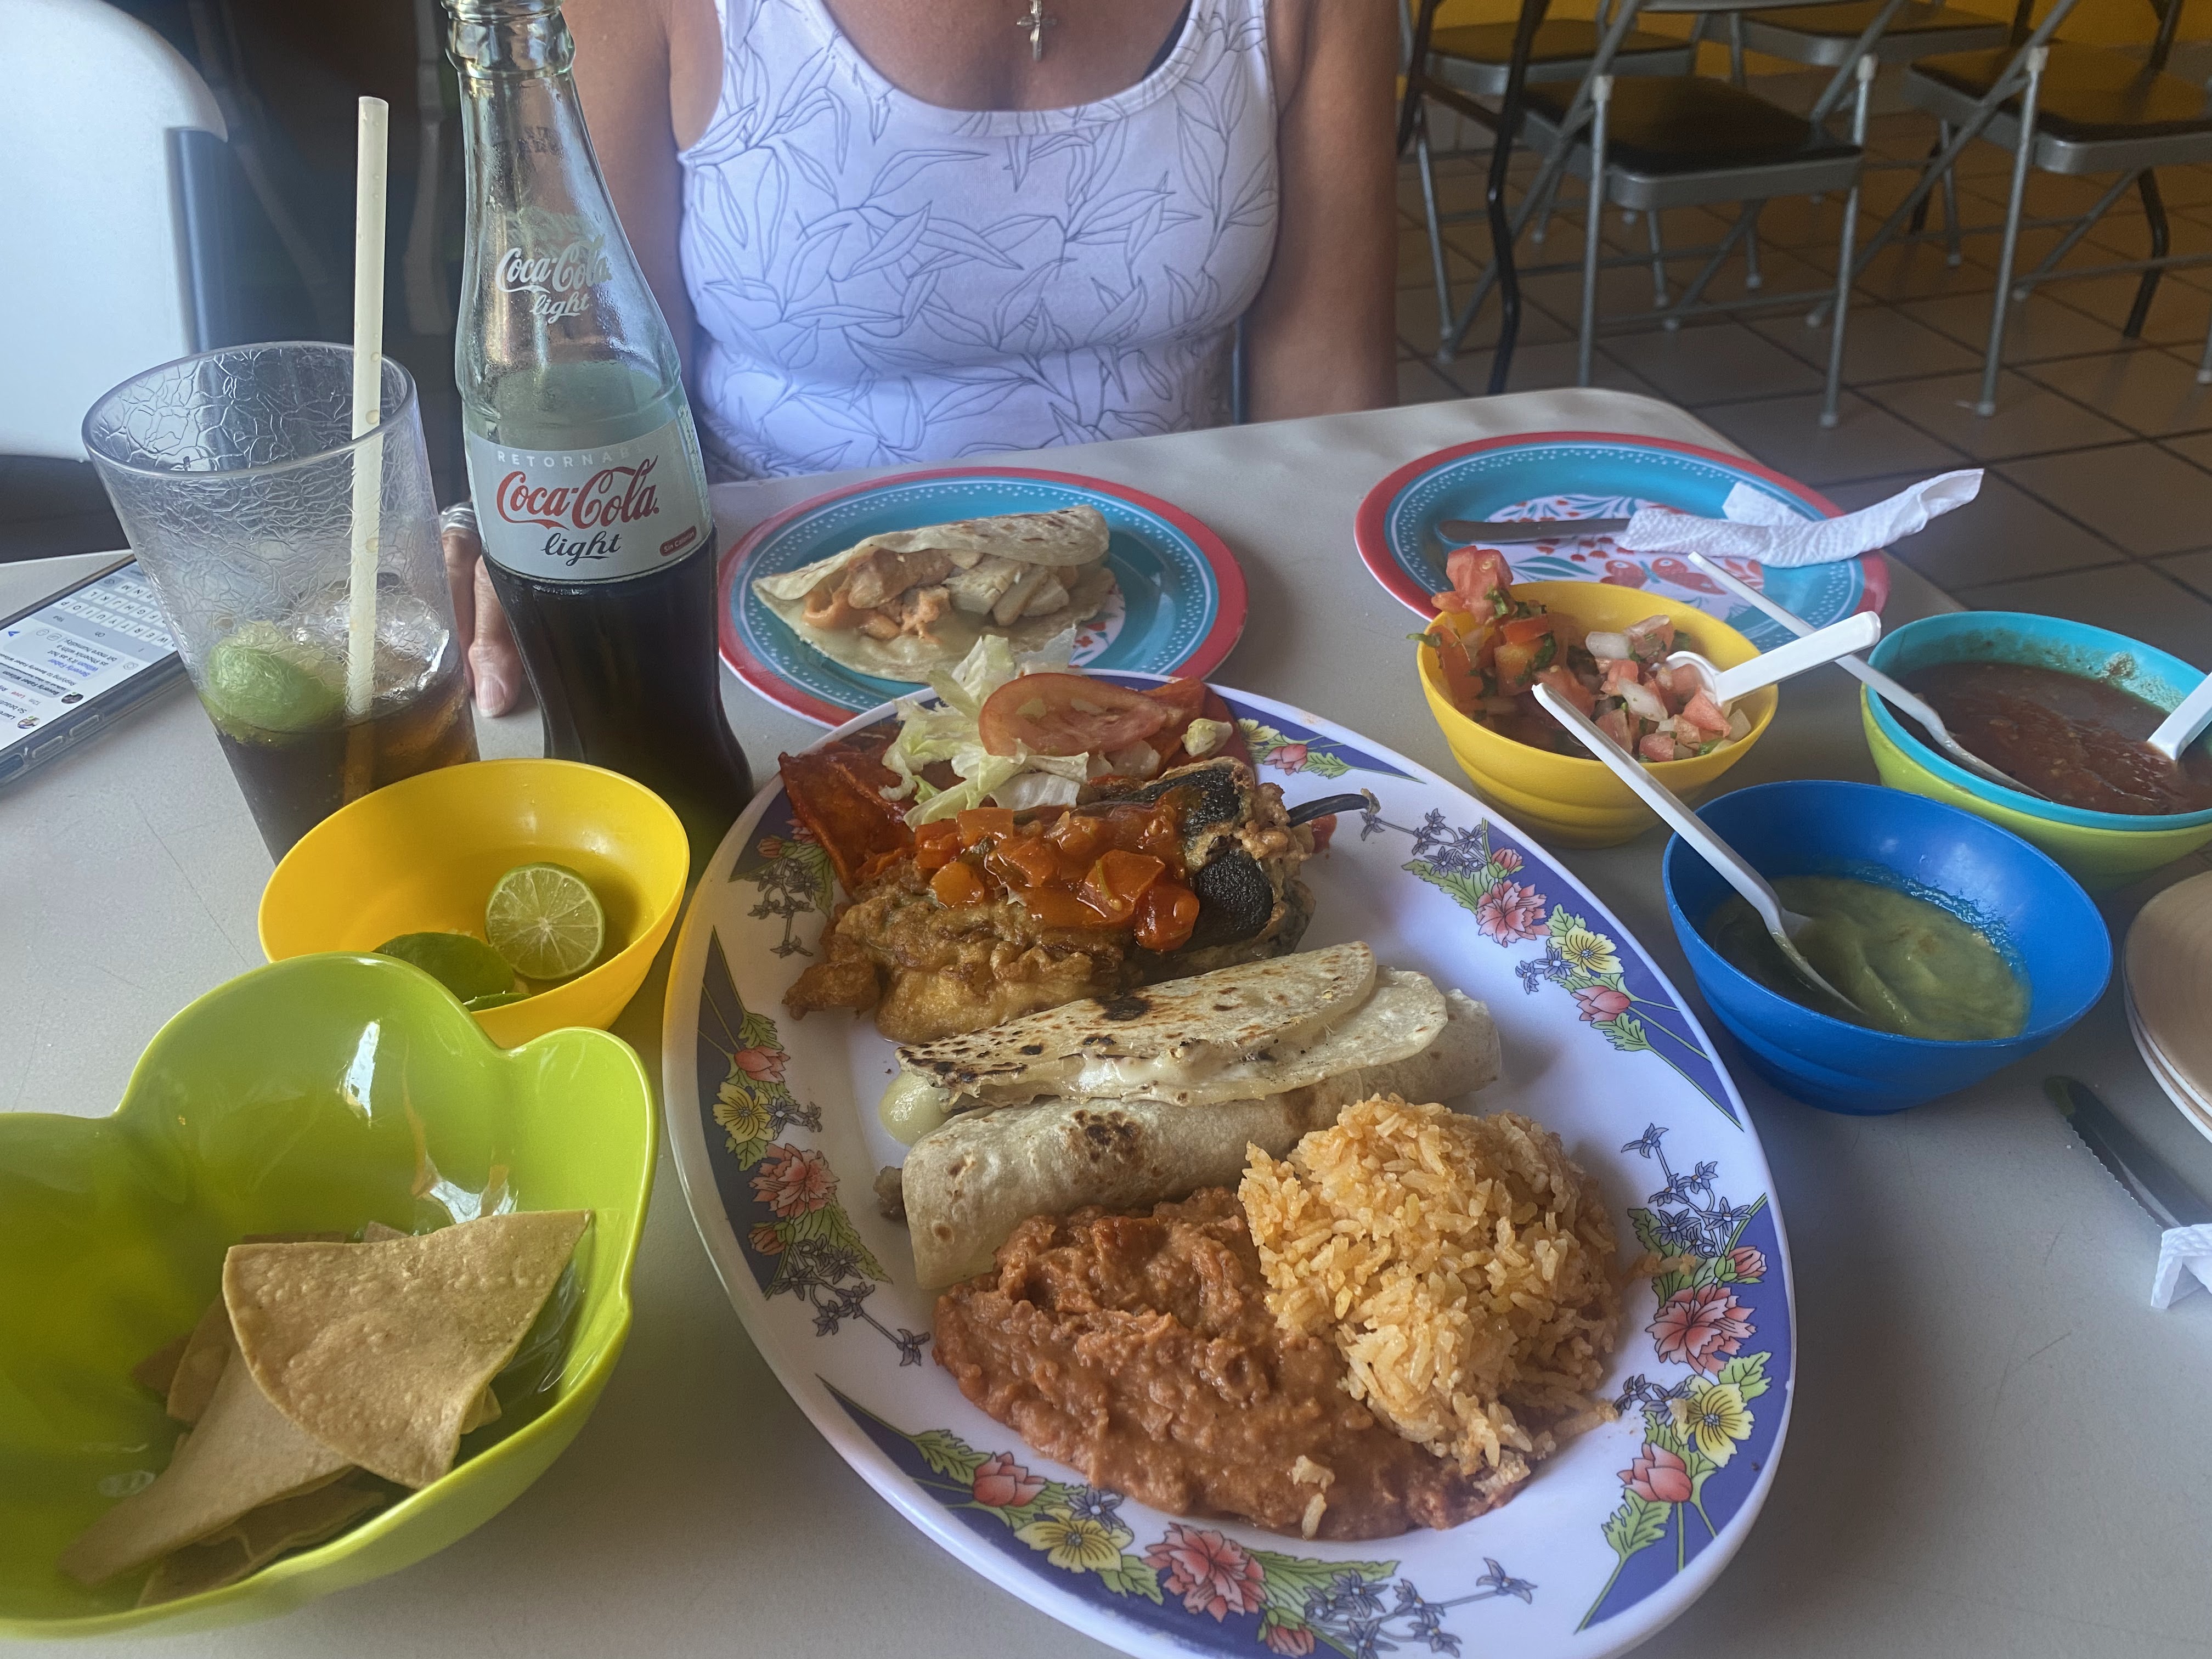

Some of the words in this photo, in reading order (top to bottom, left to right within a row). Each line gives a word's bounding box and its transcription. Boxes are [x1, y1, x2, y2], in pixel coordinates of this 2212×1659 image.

[496, 234, 612, 294] Coca-Cola
[532, 292, 589, 324] light
[496, 455, 659, 531] Coca-Cola
[541, 531, 622, 567] light
